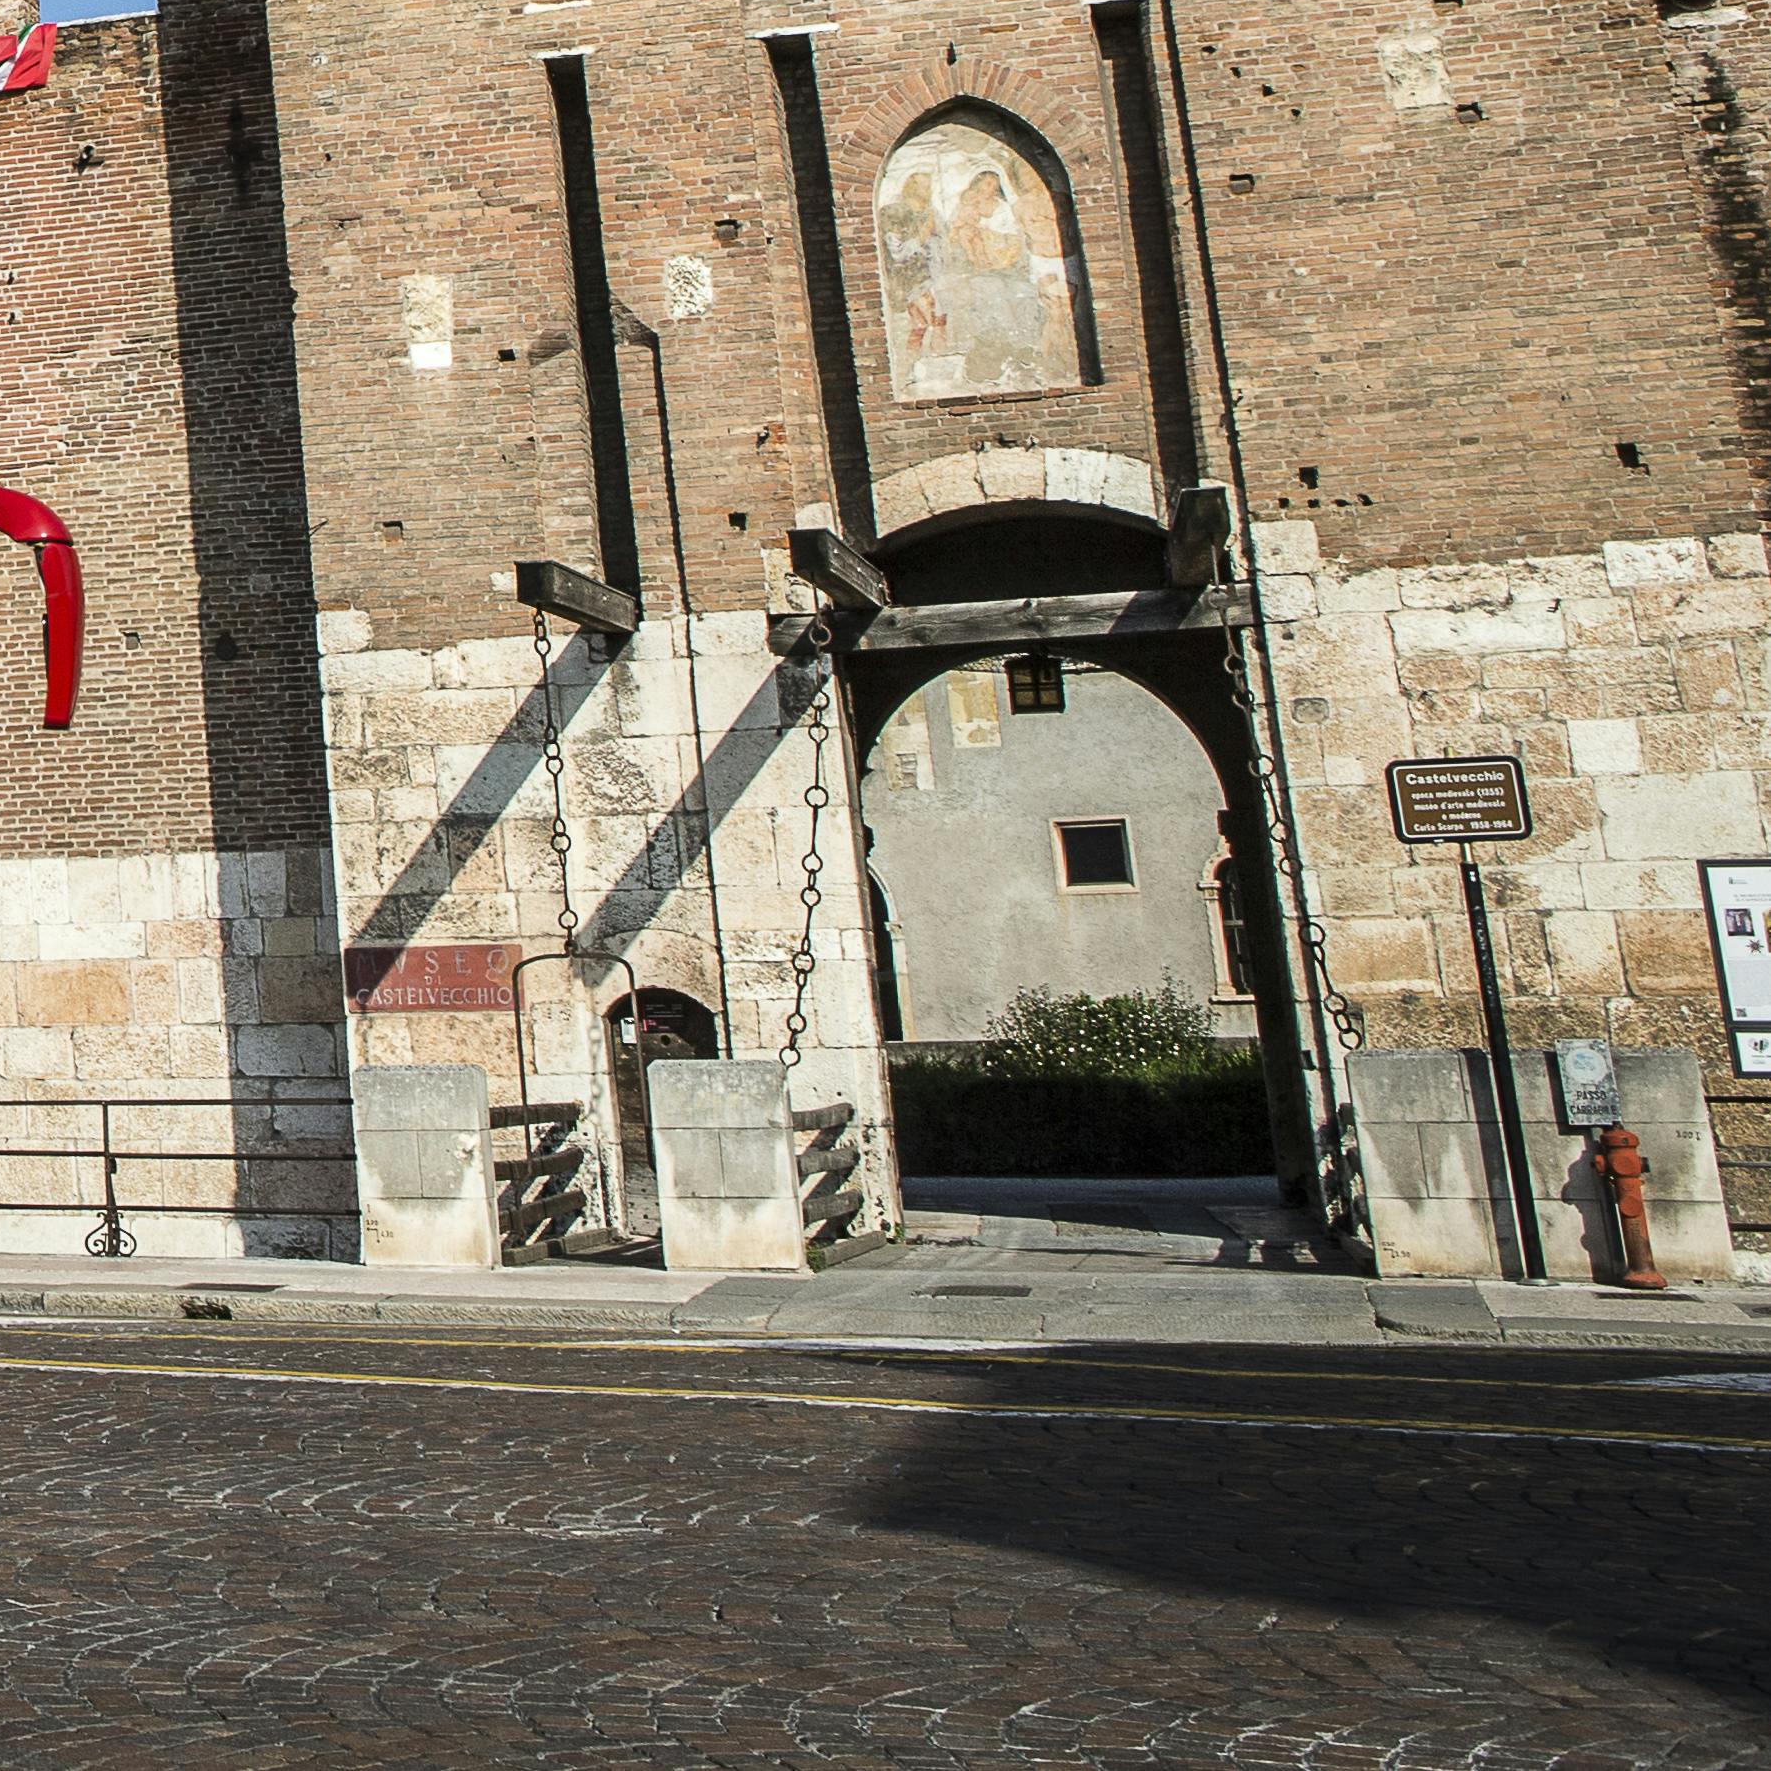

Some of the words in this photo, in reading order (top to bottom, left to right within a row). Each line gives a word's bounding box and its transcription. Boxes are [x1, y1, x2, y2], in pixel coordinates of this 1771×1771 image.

[1405, 771, 1505, 786] Castelvecchio
[357, 948, 509, 975] MVSEO
[356, 986, 513, 1006] CASTELVECCHIO
[1576, 1090, 1607, 1101] PASSO
